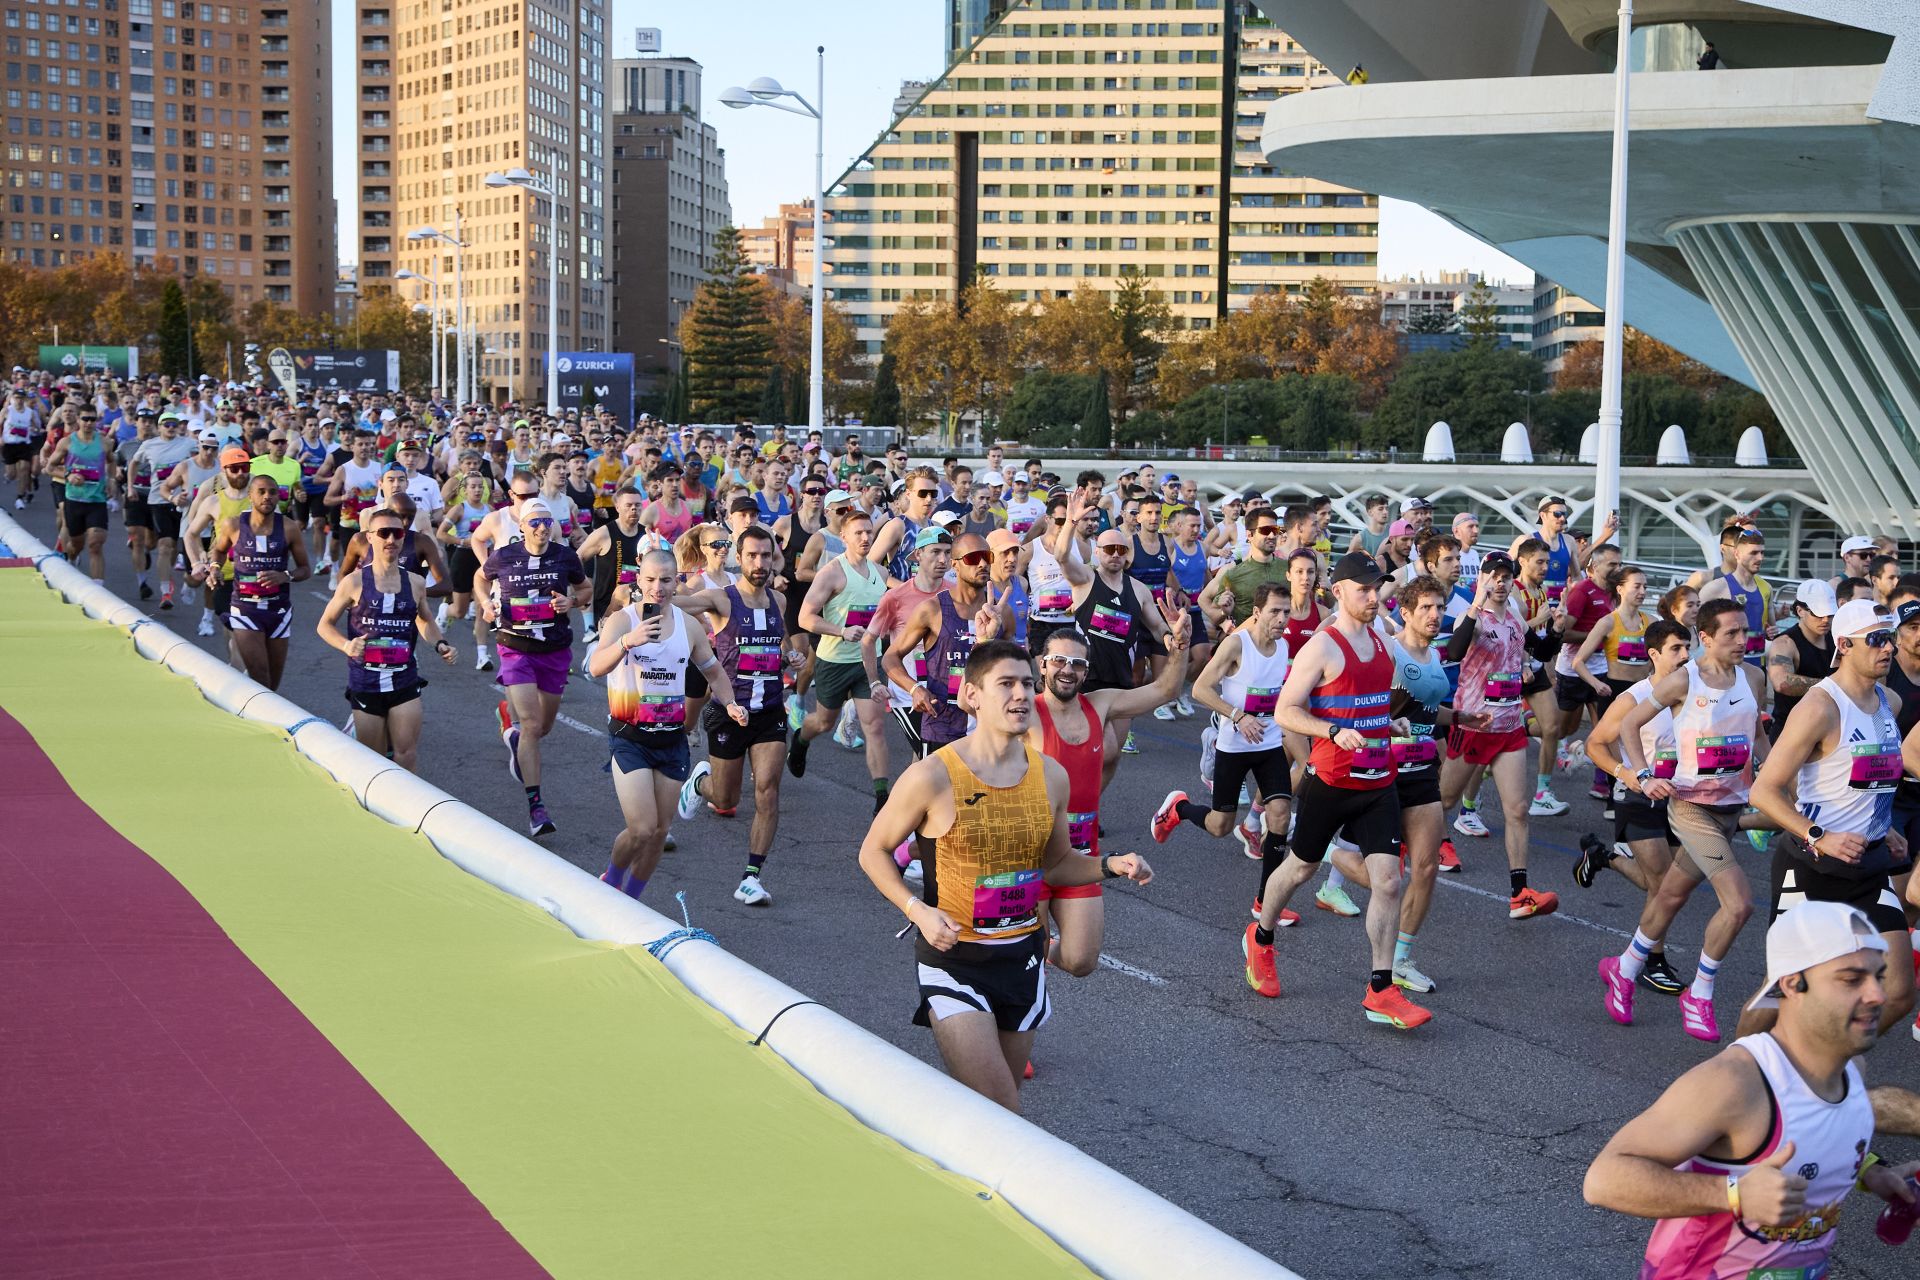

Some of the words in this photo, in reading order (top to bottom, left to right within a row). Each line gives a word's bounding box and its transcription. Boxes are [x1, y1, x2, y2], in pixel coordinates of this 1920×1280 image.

[575, 361, 615, 370] ZURICH
[523, 572, 559, 581] MEUTE
[361, 616, 375, 625] LA
[377, 619, 411, 627] MEUTE
[735, 637, 749, 645] LA
[752, 636, 782, 644] MEUTE
[640, 671, 677, 681] MARATHON
[1354, 693, 1390, 706] DULWICH
[1353, 715, 1389, 729] RUNNERS
[1000, 887, 1026, 902] 5488
